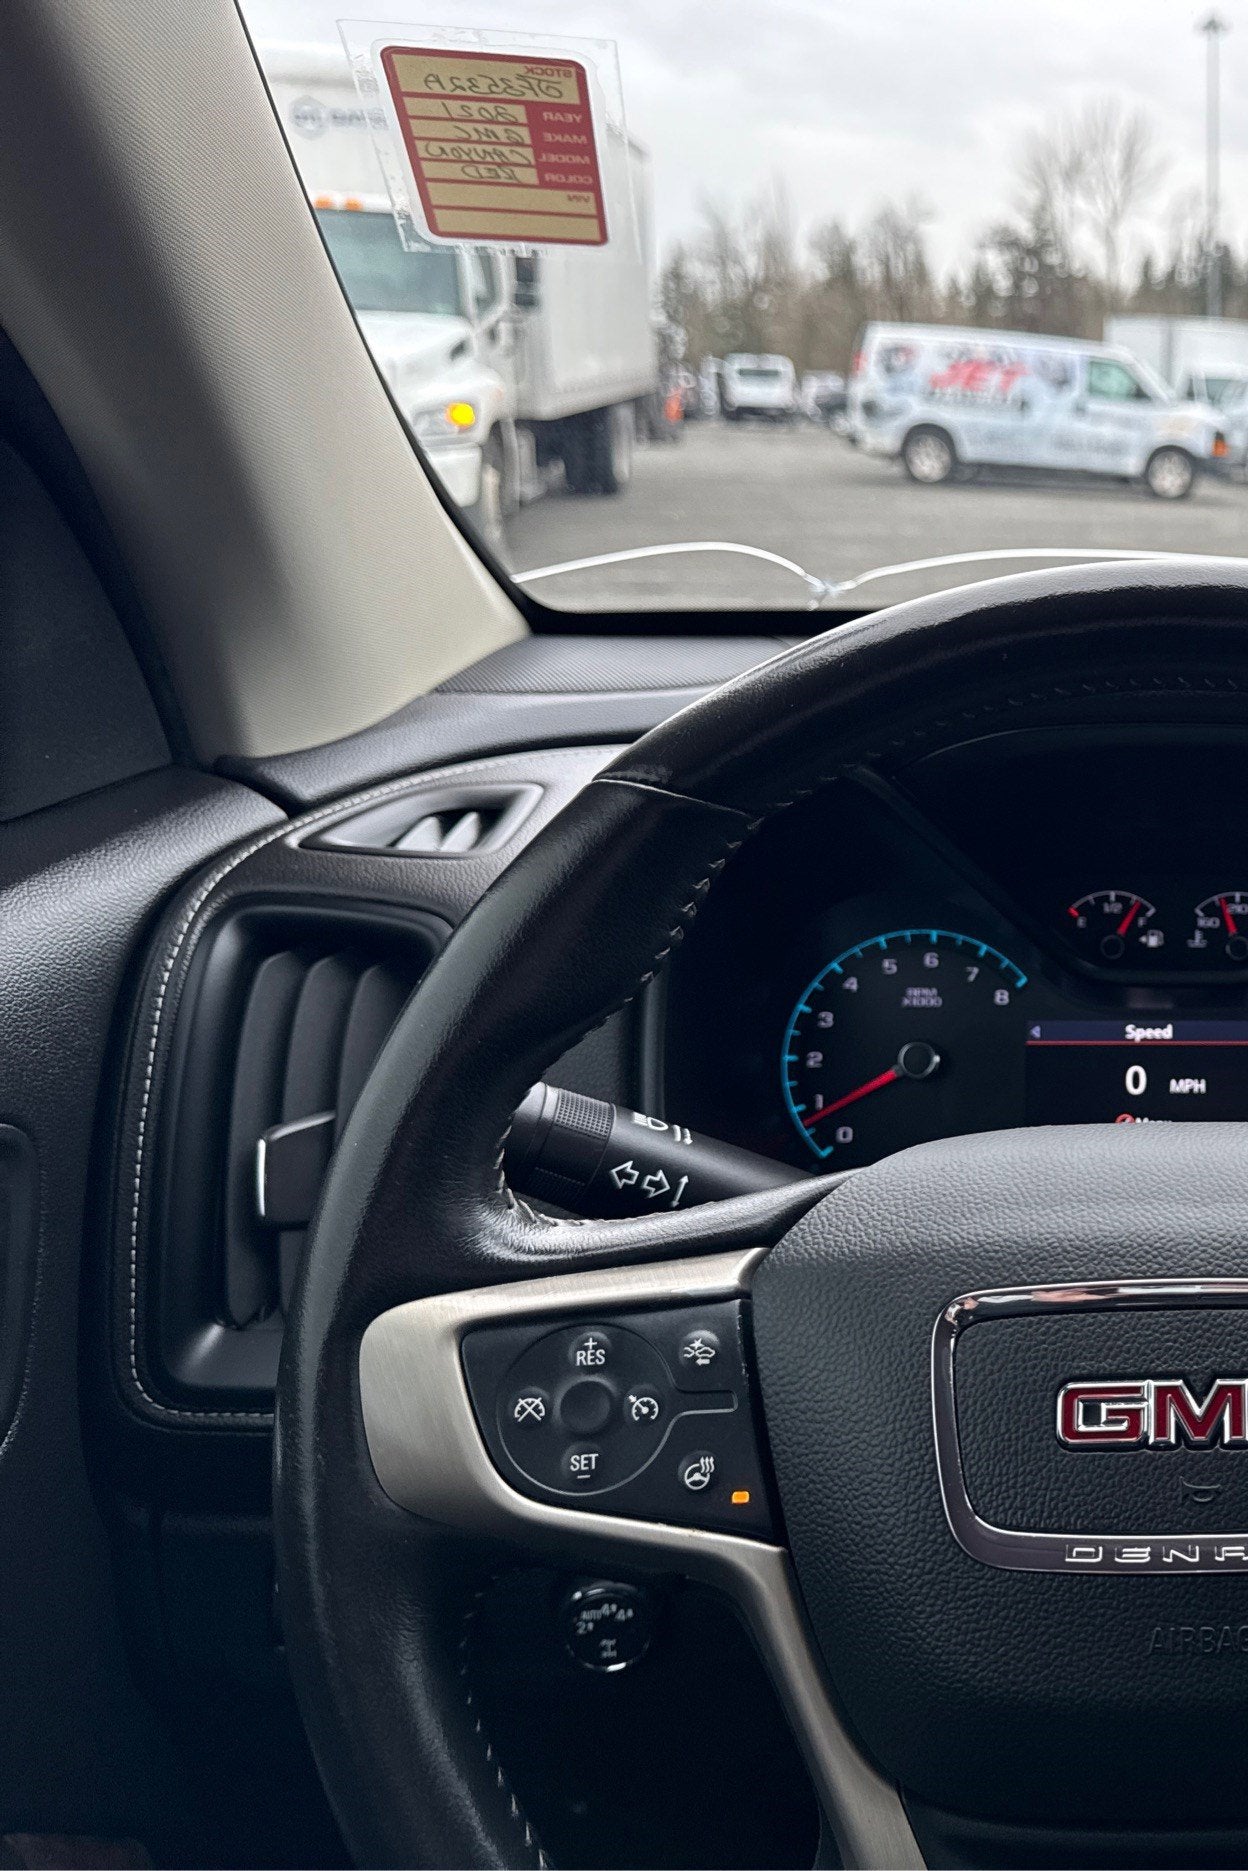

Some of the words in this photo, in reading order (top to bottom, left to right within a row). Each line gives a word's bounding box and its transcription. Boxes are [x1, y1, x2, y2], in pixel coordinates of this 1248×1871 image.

[881, 959, 898, 975] 5
[923, 953, 939, 969] 6
[966, 967, 980, 982] 7
[843, 977, 858, 992] 4
[994, 989, 1010, 1006] 8
[818, 1012, 834, 1028] 3
[1125, 1024, 1173, 1042] Speed
[806, 1052, 822, 1068] 2
[1125, 1065, 1147, 1095] 0
[1170, 1079, 1206, 1094] MPH
[814, 1095, 823, 1110] 1
[836, 1127, 853, 1144] 0
[576, 1349, 606, 1366] RES
[570, 1454, 599, 1471] SET
